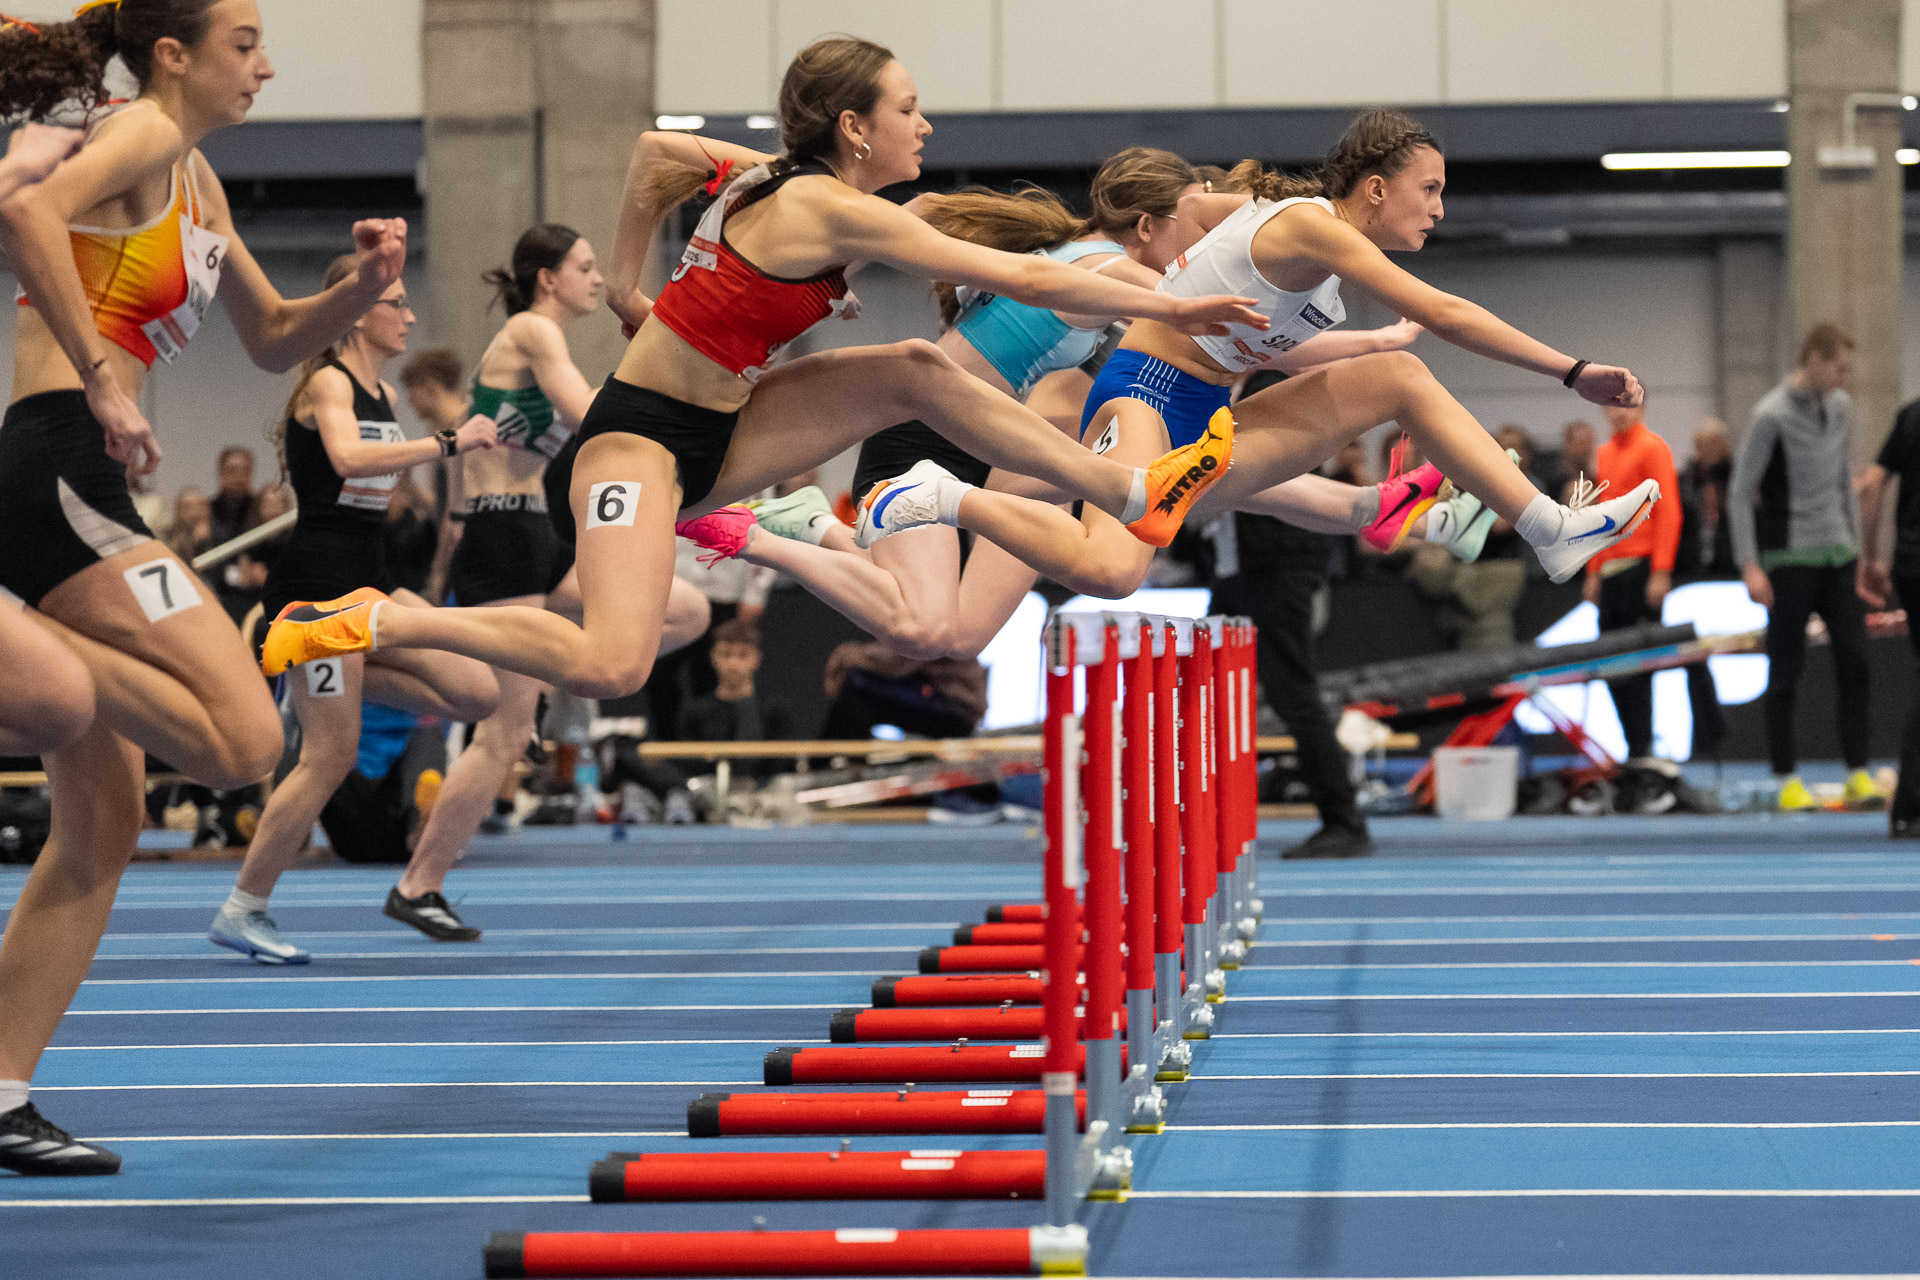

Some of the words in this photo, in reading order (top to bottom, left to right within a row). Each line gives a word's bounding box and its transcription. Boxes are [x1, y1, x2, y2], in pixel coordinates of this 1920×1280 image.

[1097, 424, 1113, 455] 5
[477, 493, 521, 512] PRO
[597, 484, 627, 522] 6
[1152, 455, 1218, 518] NITRO
[139, 564, 174, 609] 7
[314, 663, 336, 693] 2
